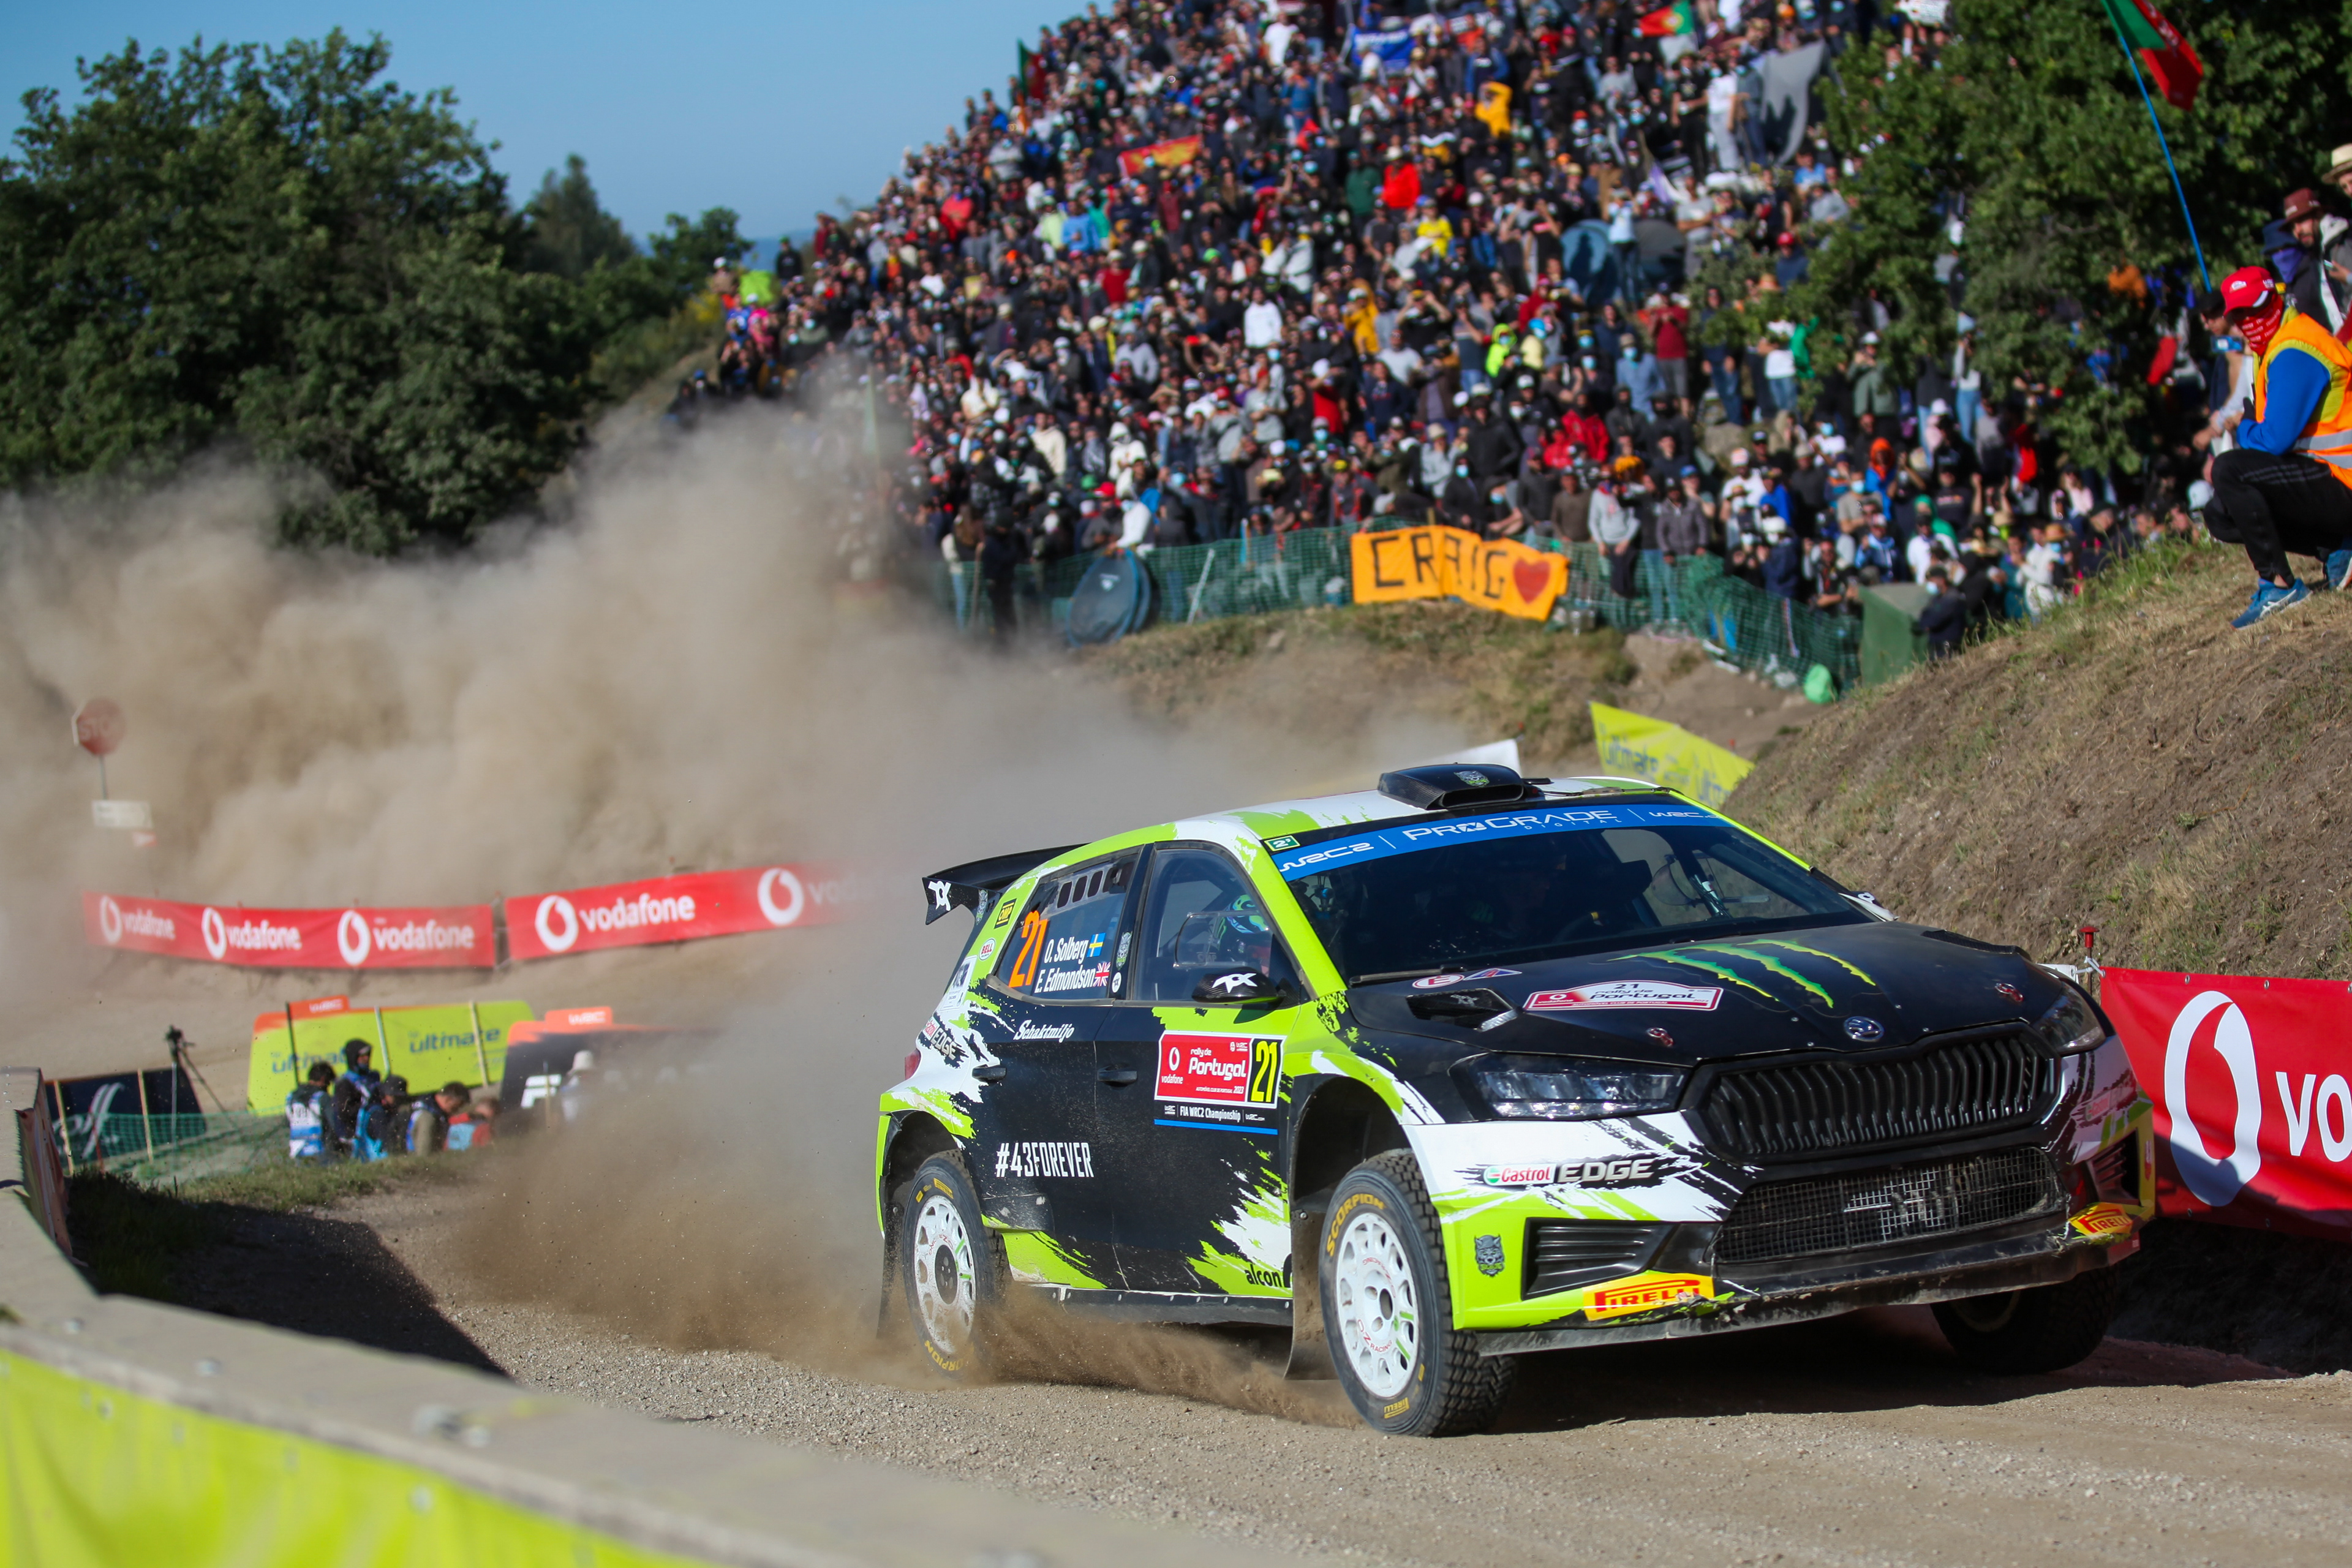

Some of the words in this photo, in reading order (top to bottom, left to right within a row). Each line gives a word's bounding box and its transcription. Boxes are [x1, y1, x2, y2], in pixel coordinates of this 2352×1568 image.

[1371, 533, 1507, 599] CRAIG
[1524, 819, 1622, 831] DIGITAL
[1280, 843, 1374, 872] WRC2
[123, 910, 176, 940] vodafone
[581, 892, 695, 933] vodafone
[998, 906, 1013, 922] OMP
[225, 920, 302, 950] vodafone
[373, 920, 475, 951] vodafone
[981, 943, 993, 955] BELL
[1008, 910, 1049, 988] 21
[1054, 937, 1090, 965] Solberg
[1043, 965, 1096, 993] Edmondson
[930, 1027, 957, 1060] EDGE
[1190, 1047, 1205, 1058] rally
[1161, 1074, 1184, 1084] vodafone
[1188, 1057, 1247, 1081] Portugal
[1251, 1041, 1278, 1102] 21
[1233, 1085, 1245, 1095] 2023
[1180, 1106, 1189, 1117] FIA
[1189, 1106, 1204, 1118] WRC2
[1205, 1107, 1241, 1123] Championship
[995, 1142, 1095, 1178] #43FOREVER
[1501, 1166, 1551, 1183] Castrol
[1557, 1158, 1656, 1183] EDGE
[1326, 1193, 1387, 1257] SCORPION
[1244, 1264, 1283, 1287] alcon
[1370, 1340, 1393, 1353] RACING
